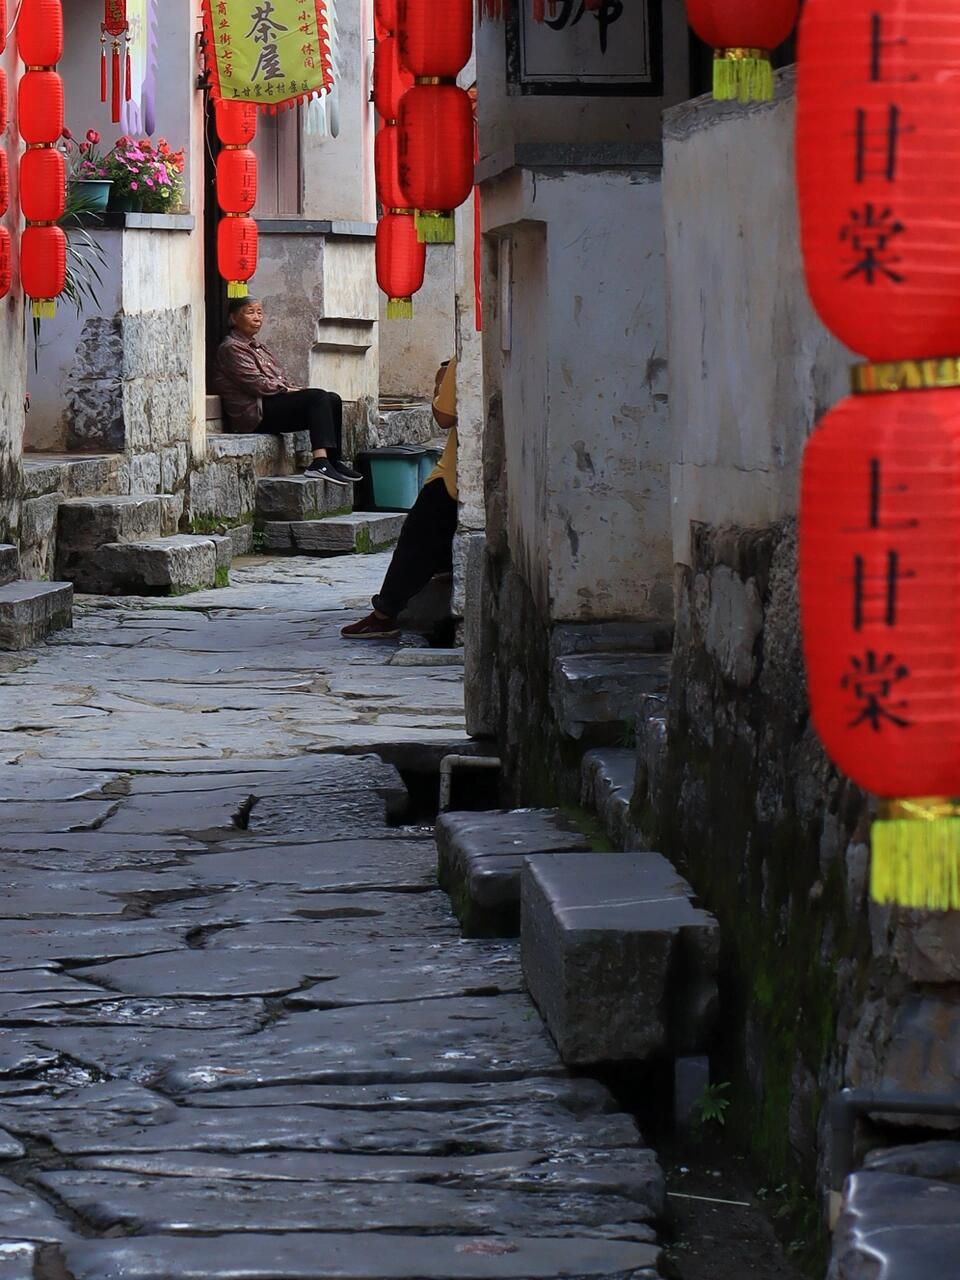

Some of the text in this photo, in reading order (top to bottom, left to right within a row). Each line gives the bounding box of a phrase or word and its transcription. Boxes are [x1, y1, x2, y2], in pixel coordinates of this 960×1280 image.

[841, 12, 919, 284] 上甘棠
[840, 456, 919, 731] 上甘棠
